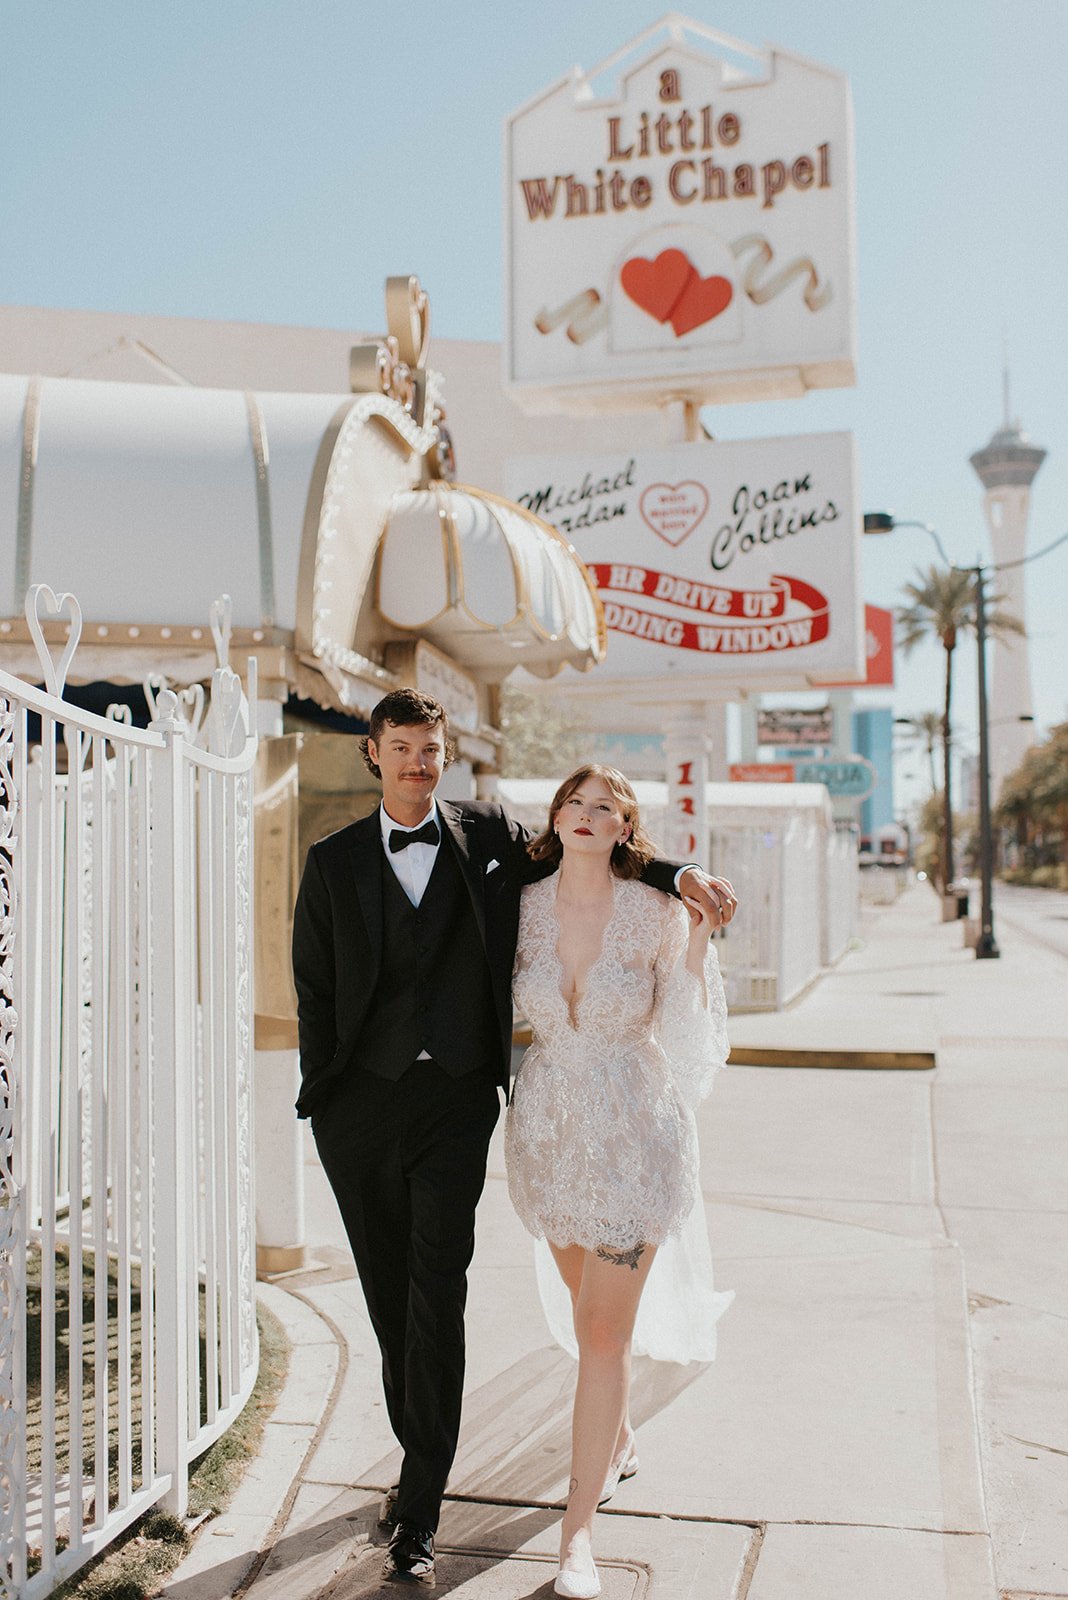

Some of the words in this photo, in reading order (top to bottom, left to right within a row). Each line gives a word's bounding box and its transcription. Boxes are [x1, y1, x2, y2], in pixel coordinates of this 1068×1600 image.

[659, 68, 682, 103] a
[607, 104, 742, 163] Little
[520, 168, 653, 222] White
[668, 142, 832, 210] Chapel
[517, 458, 637, 514] Michael
[732, 473, 811, 532] Joan
[551, 502, 626, 533] rdan
[710, 500, 839, 571] Collins
[608, 565, 647, 593] HR
[653, 573, 733, 615] DRIVE
[742, 591, 779, 618] UP
[604, 602, 684, 646] DDING
[697, 618, 813, 652] WINDOW
